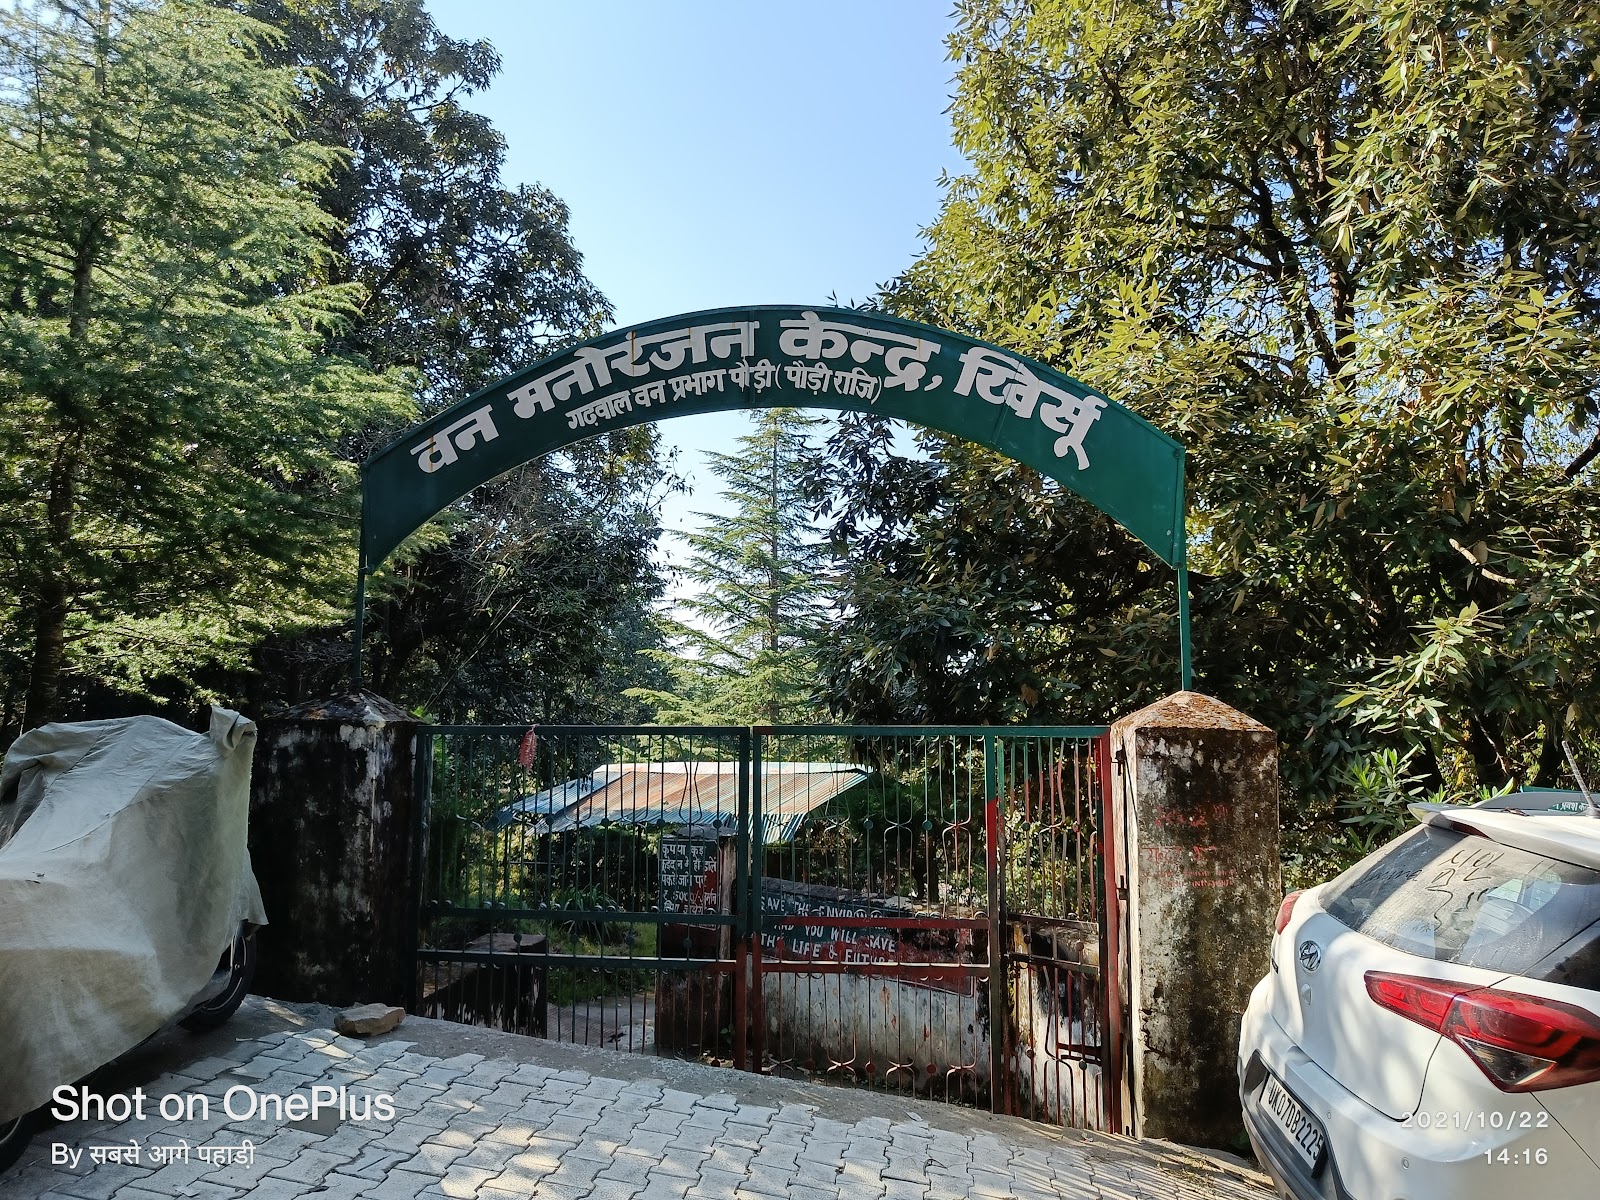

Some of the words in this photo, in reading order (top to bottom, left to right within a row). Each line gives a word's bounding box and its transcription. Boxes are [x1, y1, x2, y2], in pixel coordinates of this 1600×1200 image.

[410, 404, 500, 474] वन
[507, 320, 760, 419] मनोरंजन
[565, 390, 634, 430] गढ़वाल
[630, 379, 667, 408] वन
[668, 368, 728, 402] प्रभाग
[792, 938, 822, 958] LIFE
[804, 924, 824, 938] YOU
[830, 926, 858, 945] WILL
